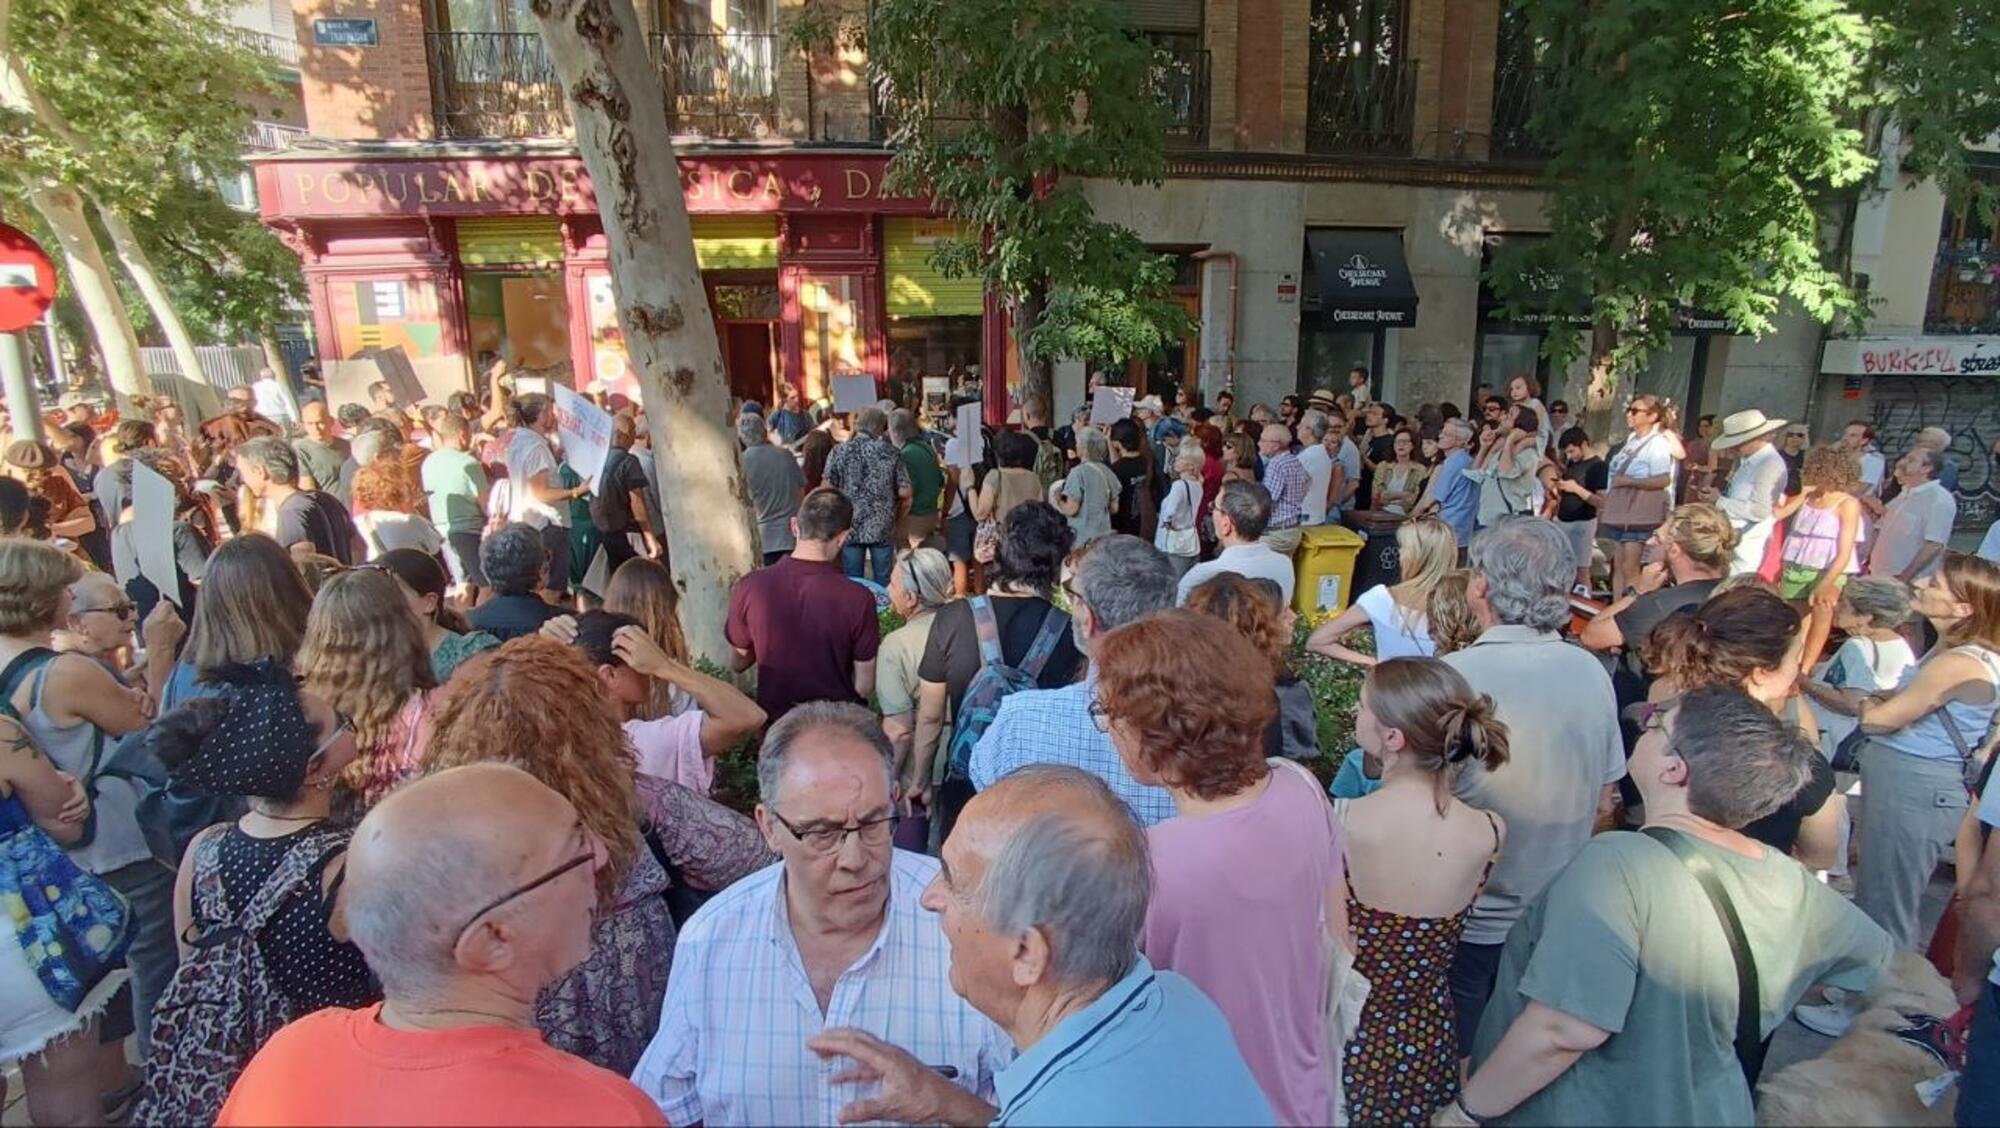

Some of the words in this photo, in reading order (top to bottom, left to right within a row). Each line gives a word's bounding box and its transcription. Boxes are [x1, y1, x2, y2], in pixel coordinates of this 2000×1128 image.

[296, 171, 493, 203] POPULAR
[527, 169, 579, 201] DE
[679, 169, 784, 200] SICA
